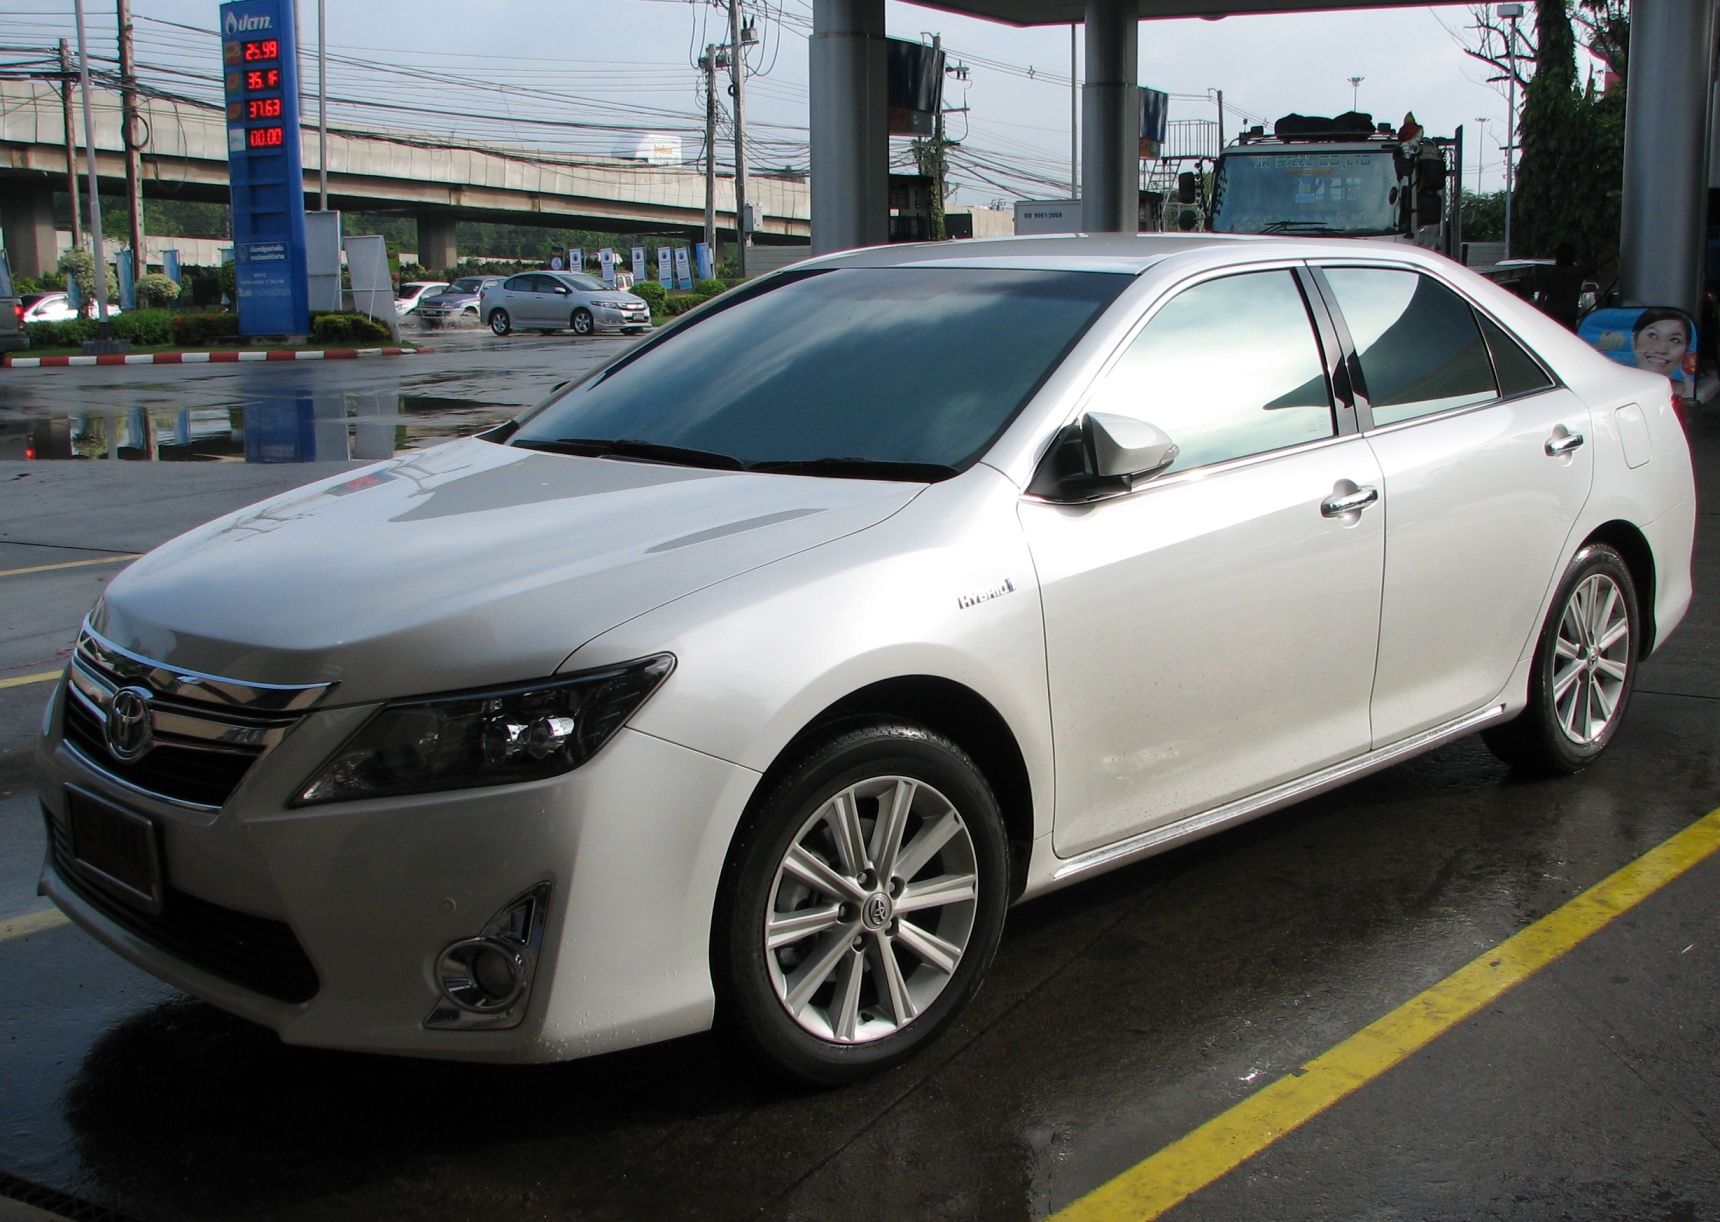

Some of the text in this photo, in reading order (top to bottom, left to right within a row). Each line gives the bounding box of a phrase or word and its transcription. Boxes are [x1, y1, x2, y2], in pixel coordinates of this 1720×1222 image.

[245, 40, 278, 60] 25.99
[250, 128, 282, 146] 00.00
[1275, 154, 1314, 168] STEEL
